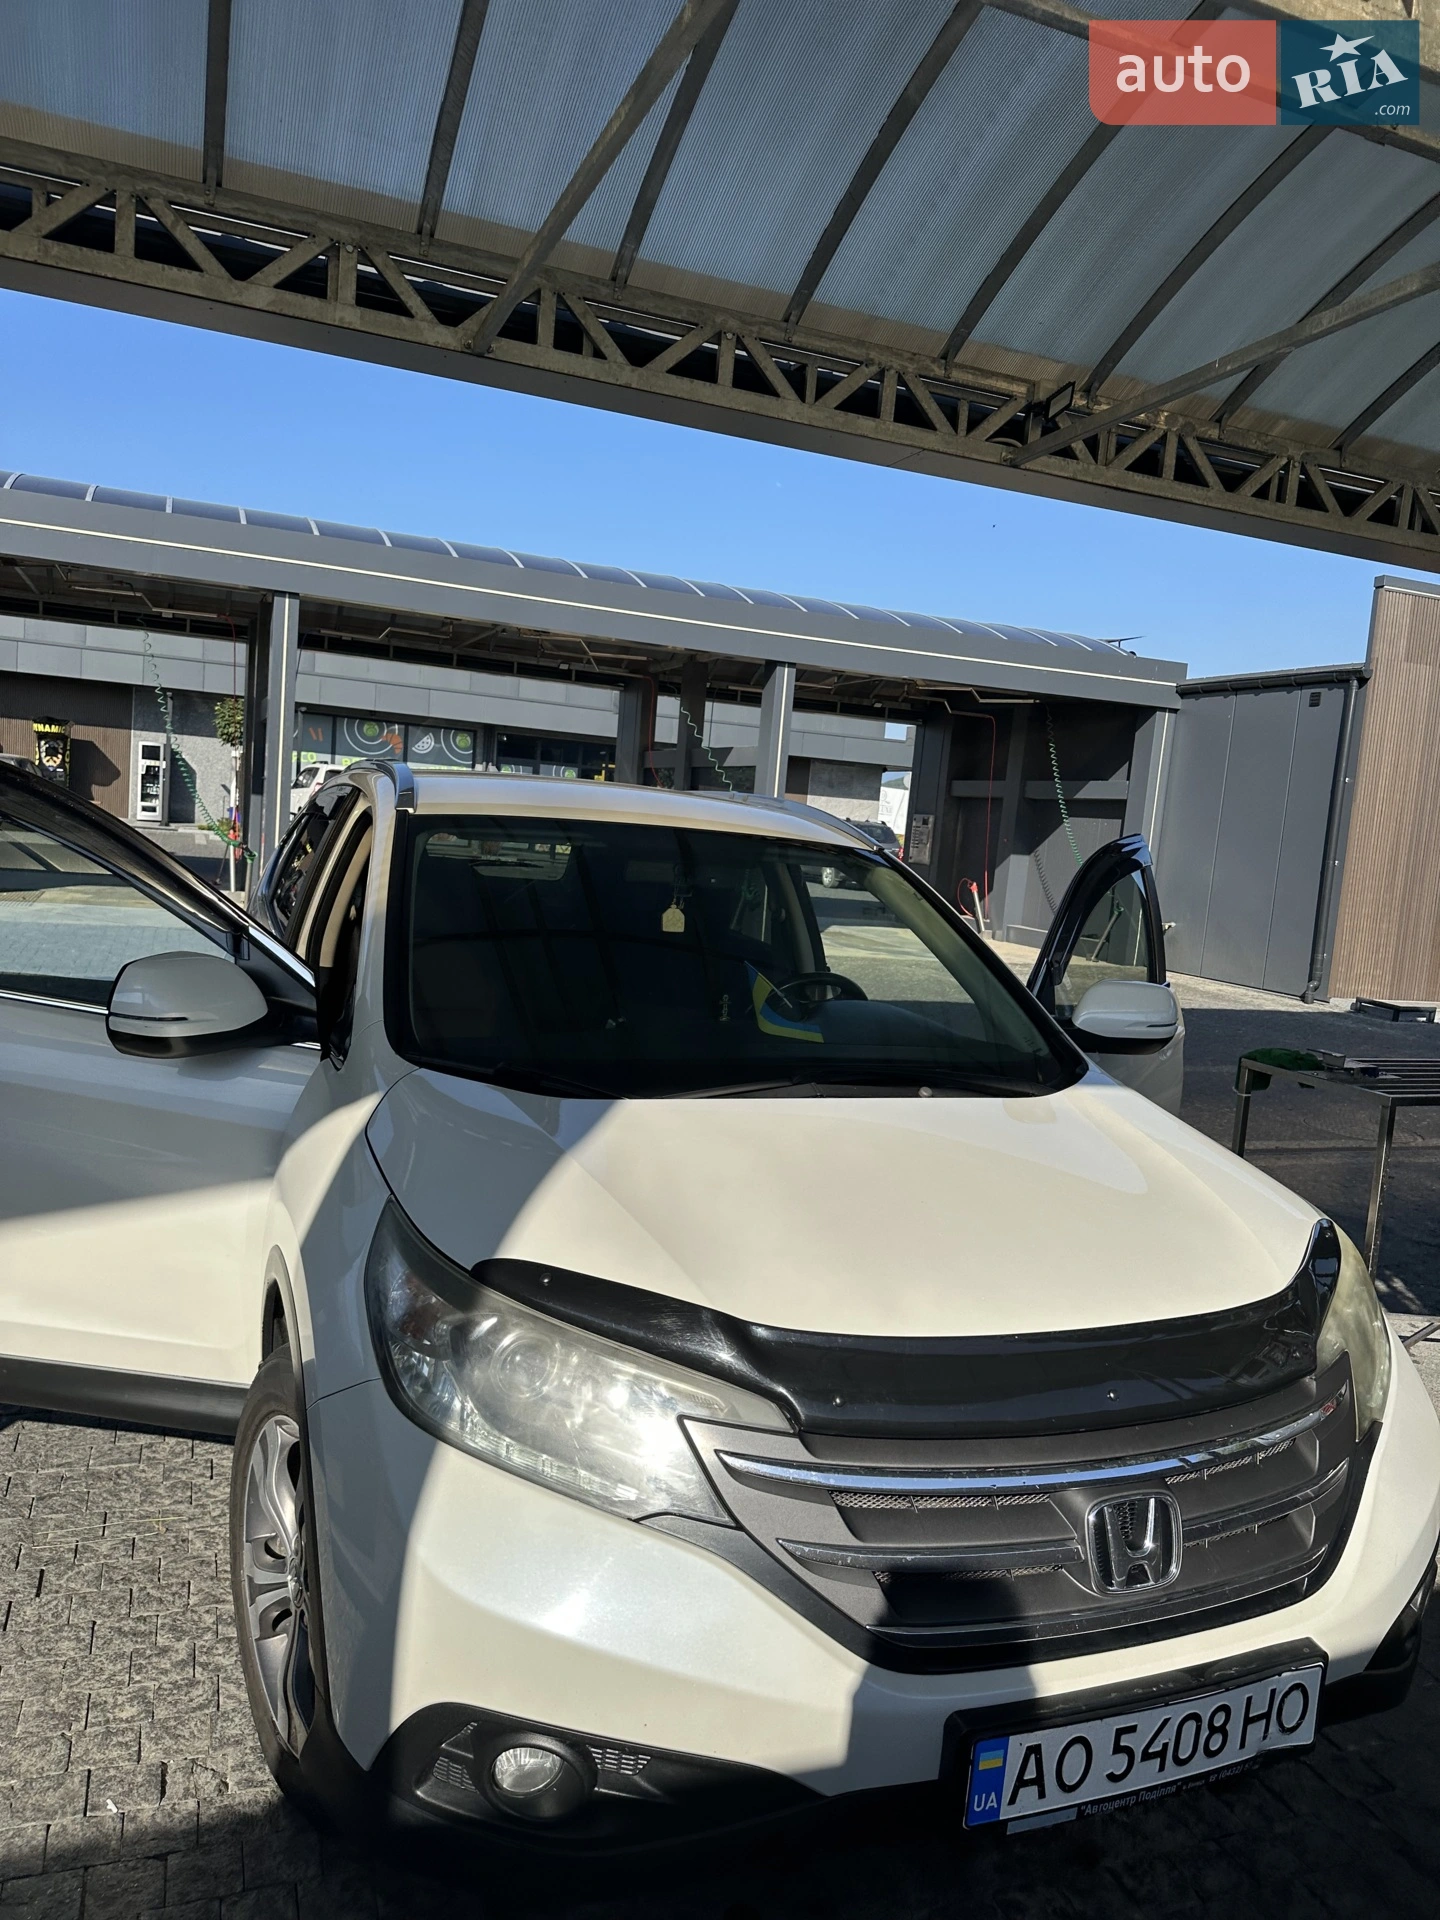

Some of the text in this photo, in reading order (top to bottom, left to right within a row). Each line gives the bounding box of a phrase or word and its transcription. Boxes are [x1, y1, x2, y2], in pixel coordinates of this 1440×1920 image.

[1007, 1681, 1310, 1806] AO 5408 HO
[973, 1792, 998, 1812] UA
